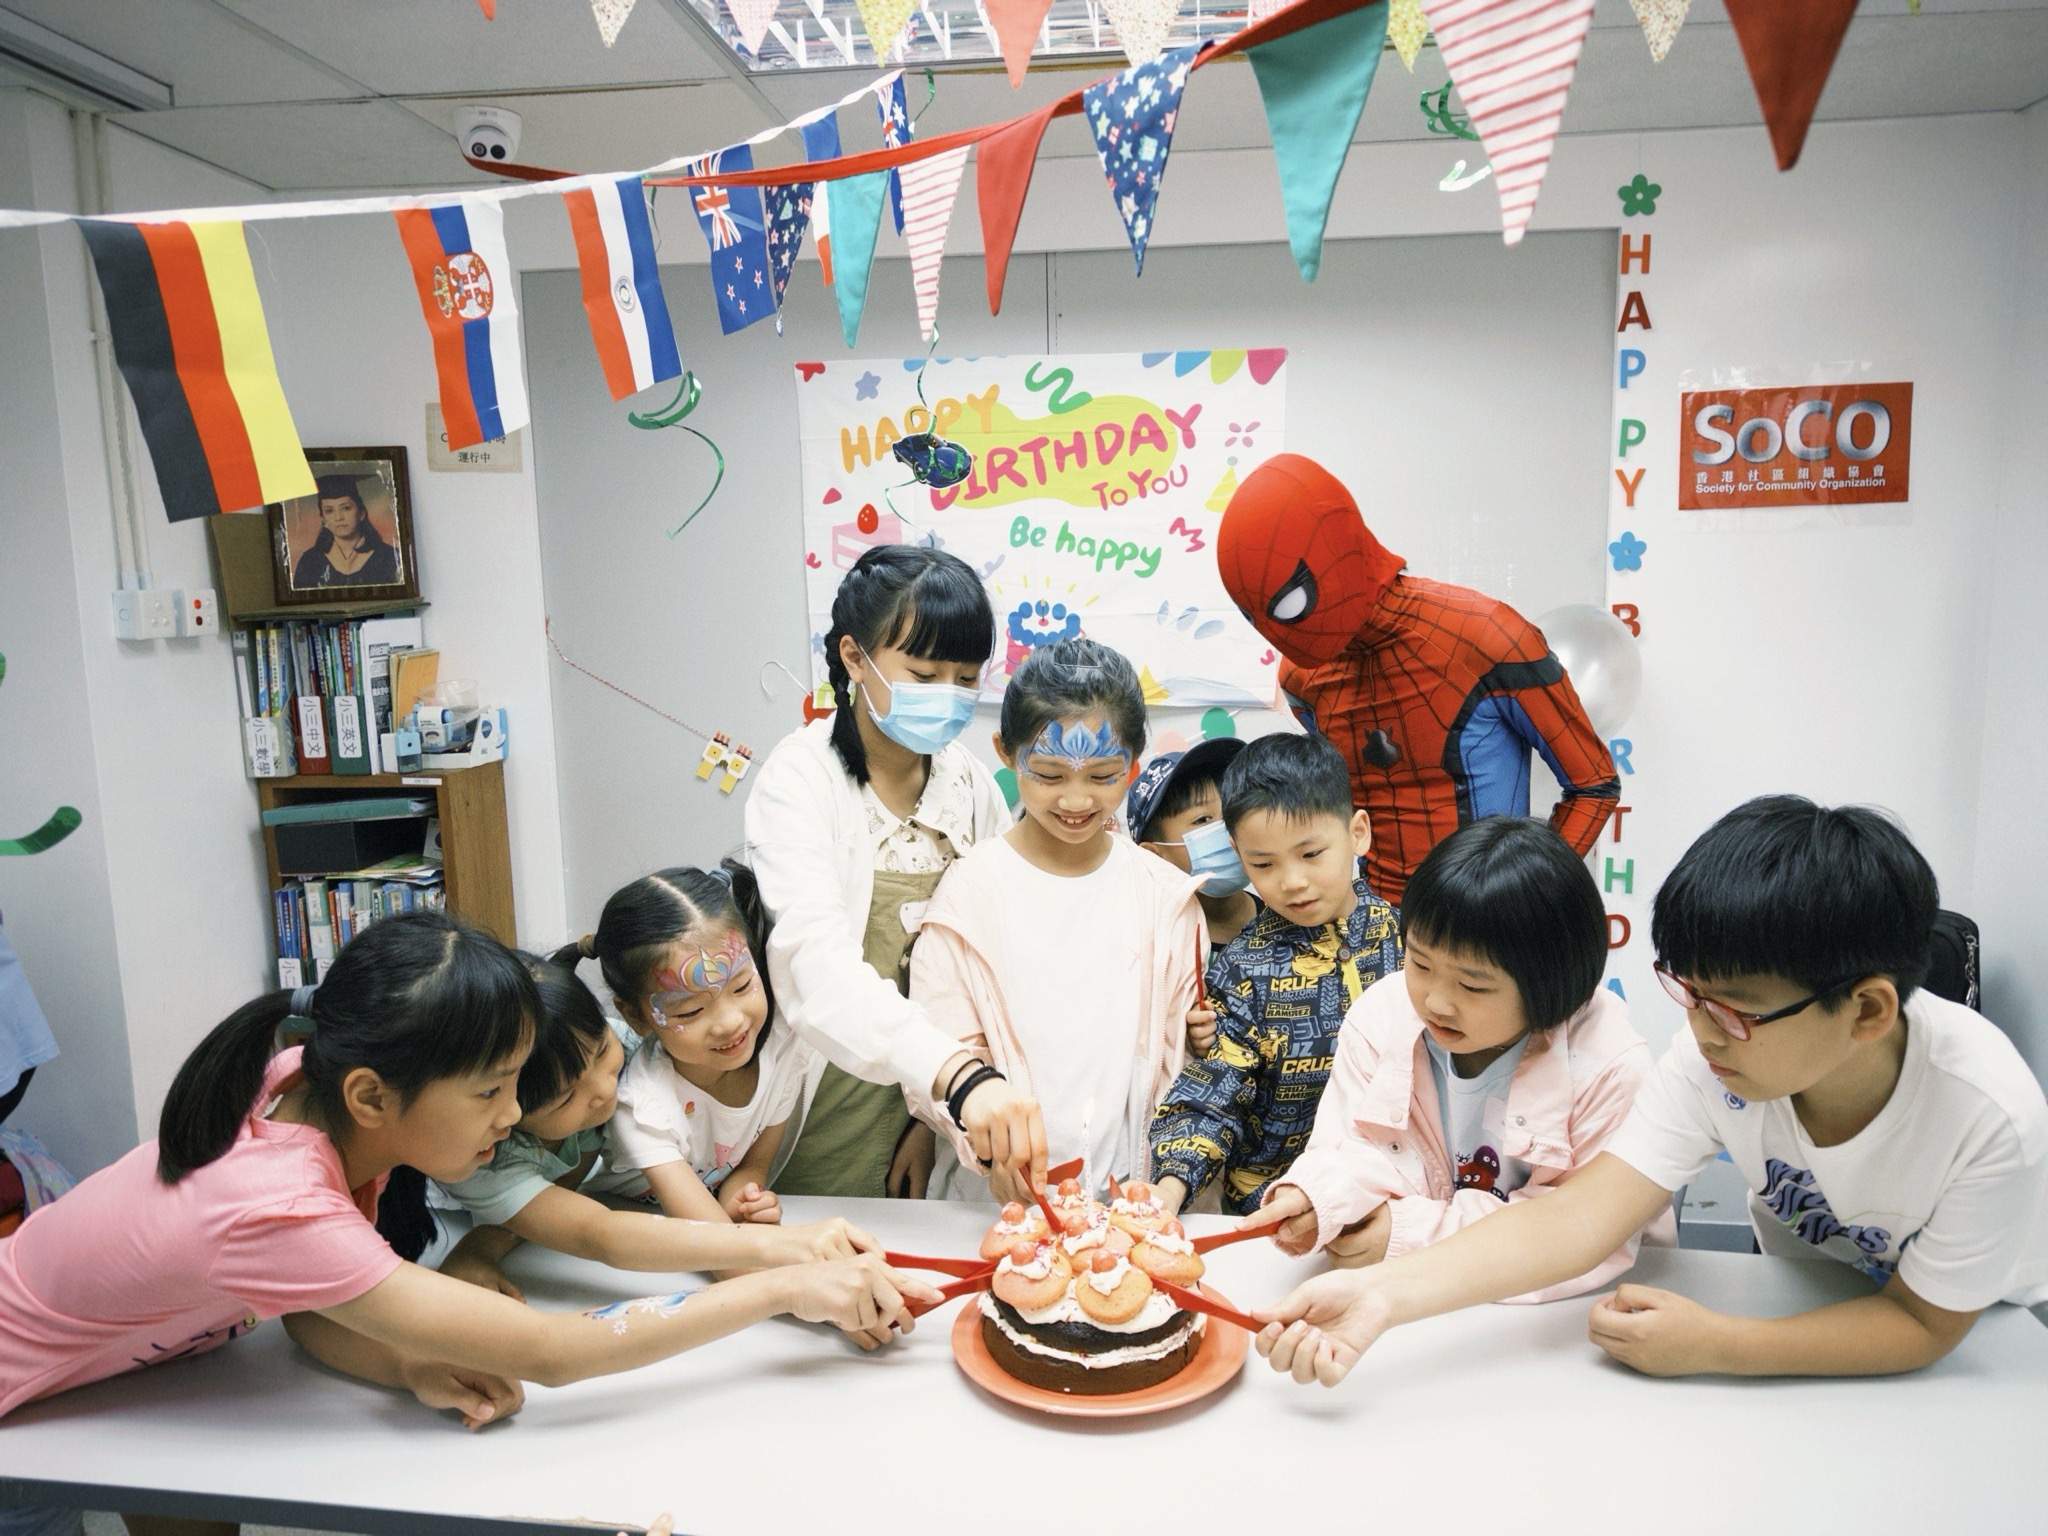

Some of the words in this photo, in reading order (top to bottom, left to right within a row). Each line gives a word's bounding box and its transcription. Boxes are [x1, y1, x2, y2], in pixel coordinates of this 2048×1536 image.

[1616, 233, 1653, 508] HAPPY
[841, 384, 1000, 474] HAPPY
[1692, 400, 1892, 466] SoCO
[1696, 482, 1735, 494] Society
[1739, 482, 1753, 491] for
[1756, 480, 1816, 491] Community
[1820, 478, 1885, 490] Organization
[1009, 515, 1047, 548] Be
[1055, 520, 1163, 578] happy
[303, 699, 321, 755] 小三中文
[339, 699, 357, 755] 小三英文
[1270, 975, 1319, 992] CRUZ
